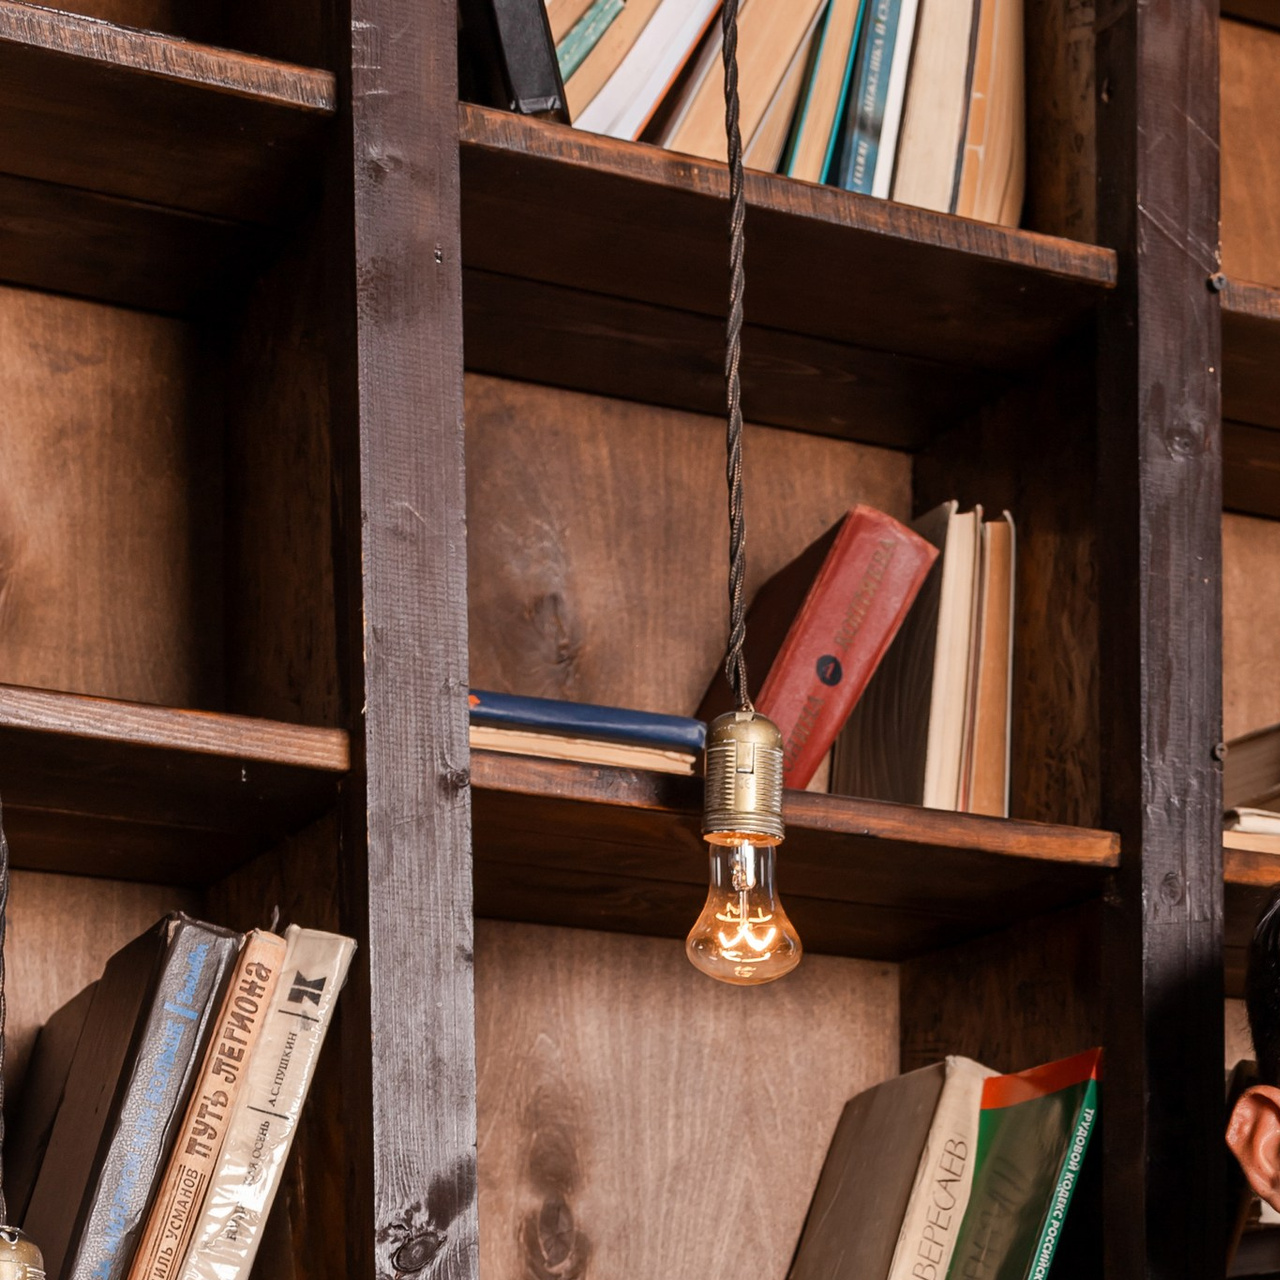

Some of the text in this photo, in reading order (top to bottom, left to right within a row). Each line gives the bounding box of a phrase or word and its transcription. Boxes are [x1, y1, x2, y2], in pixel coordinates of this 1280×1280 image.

[187, 961, 273, 1160] ПУТЬ ЛЕГИОНА
[1067, 1107, 1094, 1172] ТРУДОВОЙ
[165, 1167, 200, 1240] УСМАНОВ
[1053, 1167, 1077, 1222] КОДЕКС
